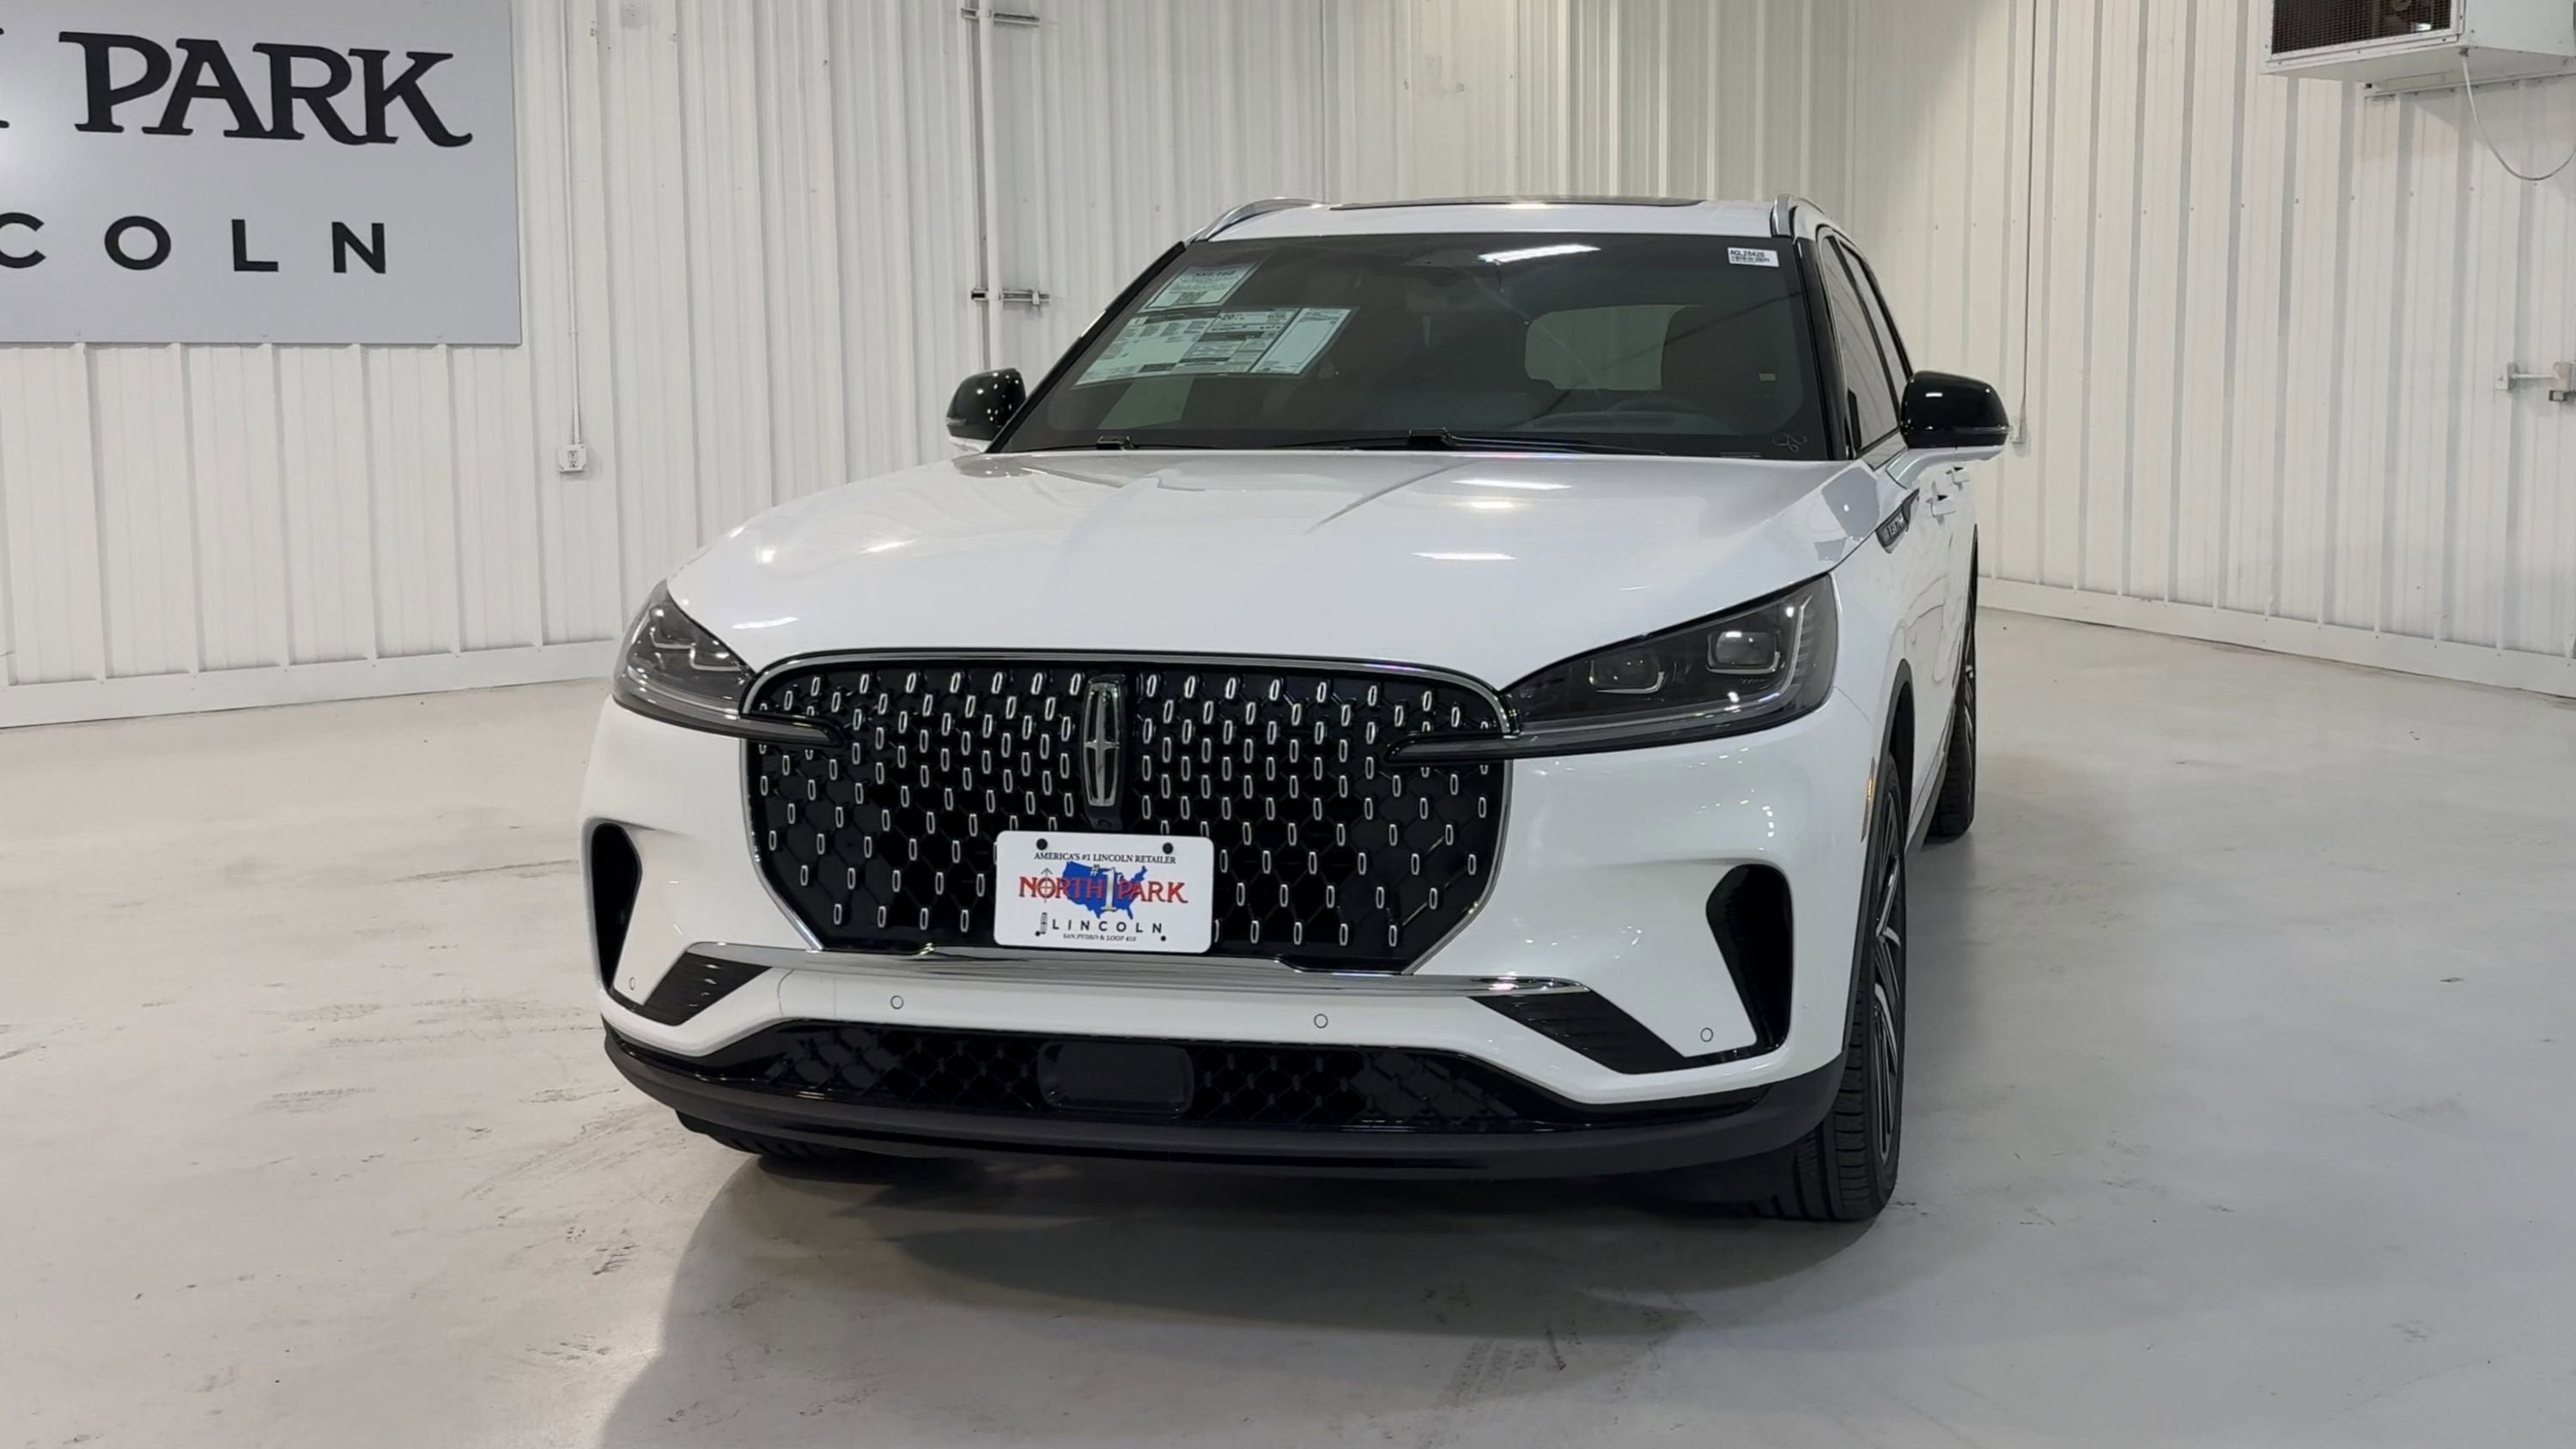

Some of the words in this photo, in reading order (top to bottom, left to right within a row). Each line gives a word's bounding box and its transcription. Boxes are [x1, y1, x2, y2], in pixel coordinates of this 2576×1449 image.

[58, 31, 474, 149] PARK
[1034, 852, 1080, 861] AMERICA'S
[1093, 854, 1133, 863] LINCOLN
[1134, 855, 1176, 864] RETAILER
[1019, 876, 1103, 900] NORTH
[1118, 878, 1188, 904] PARK
[1052, 919, 1162, 934] LINCOLN
